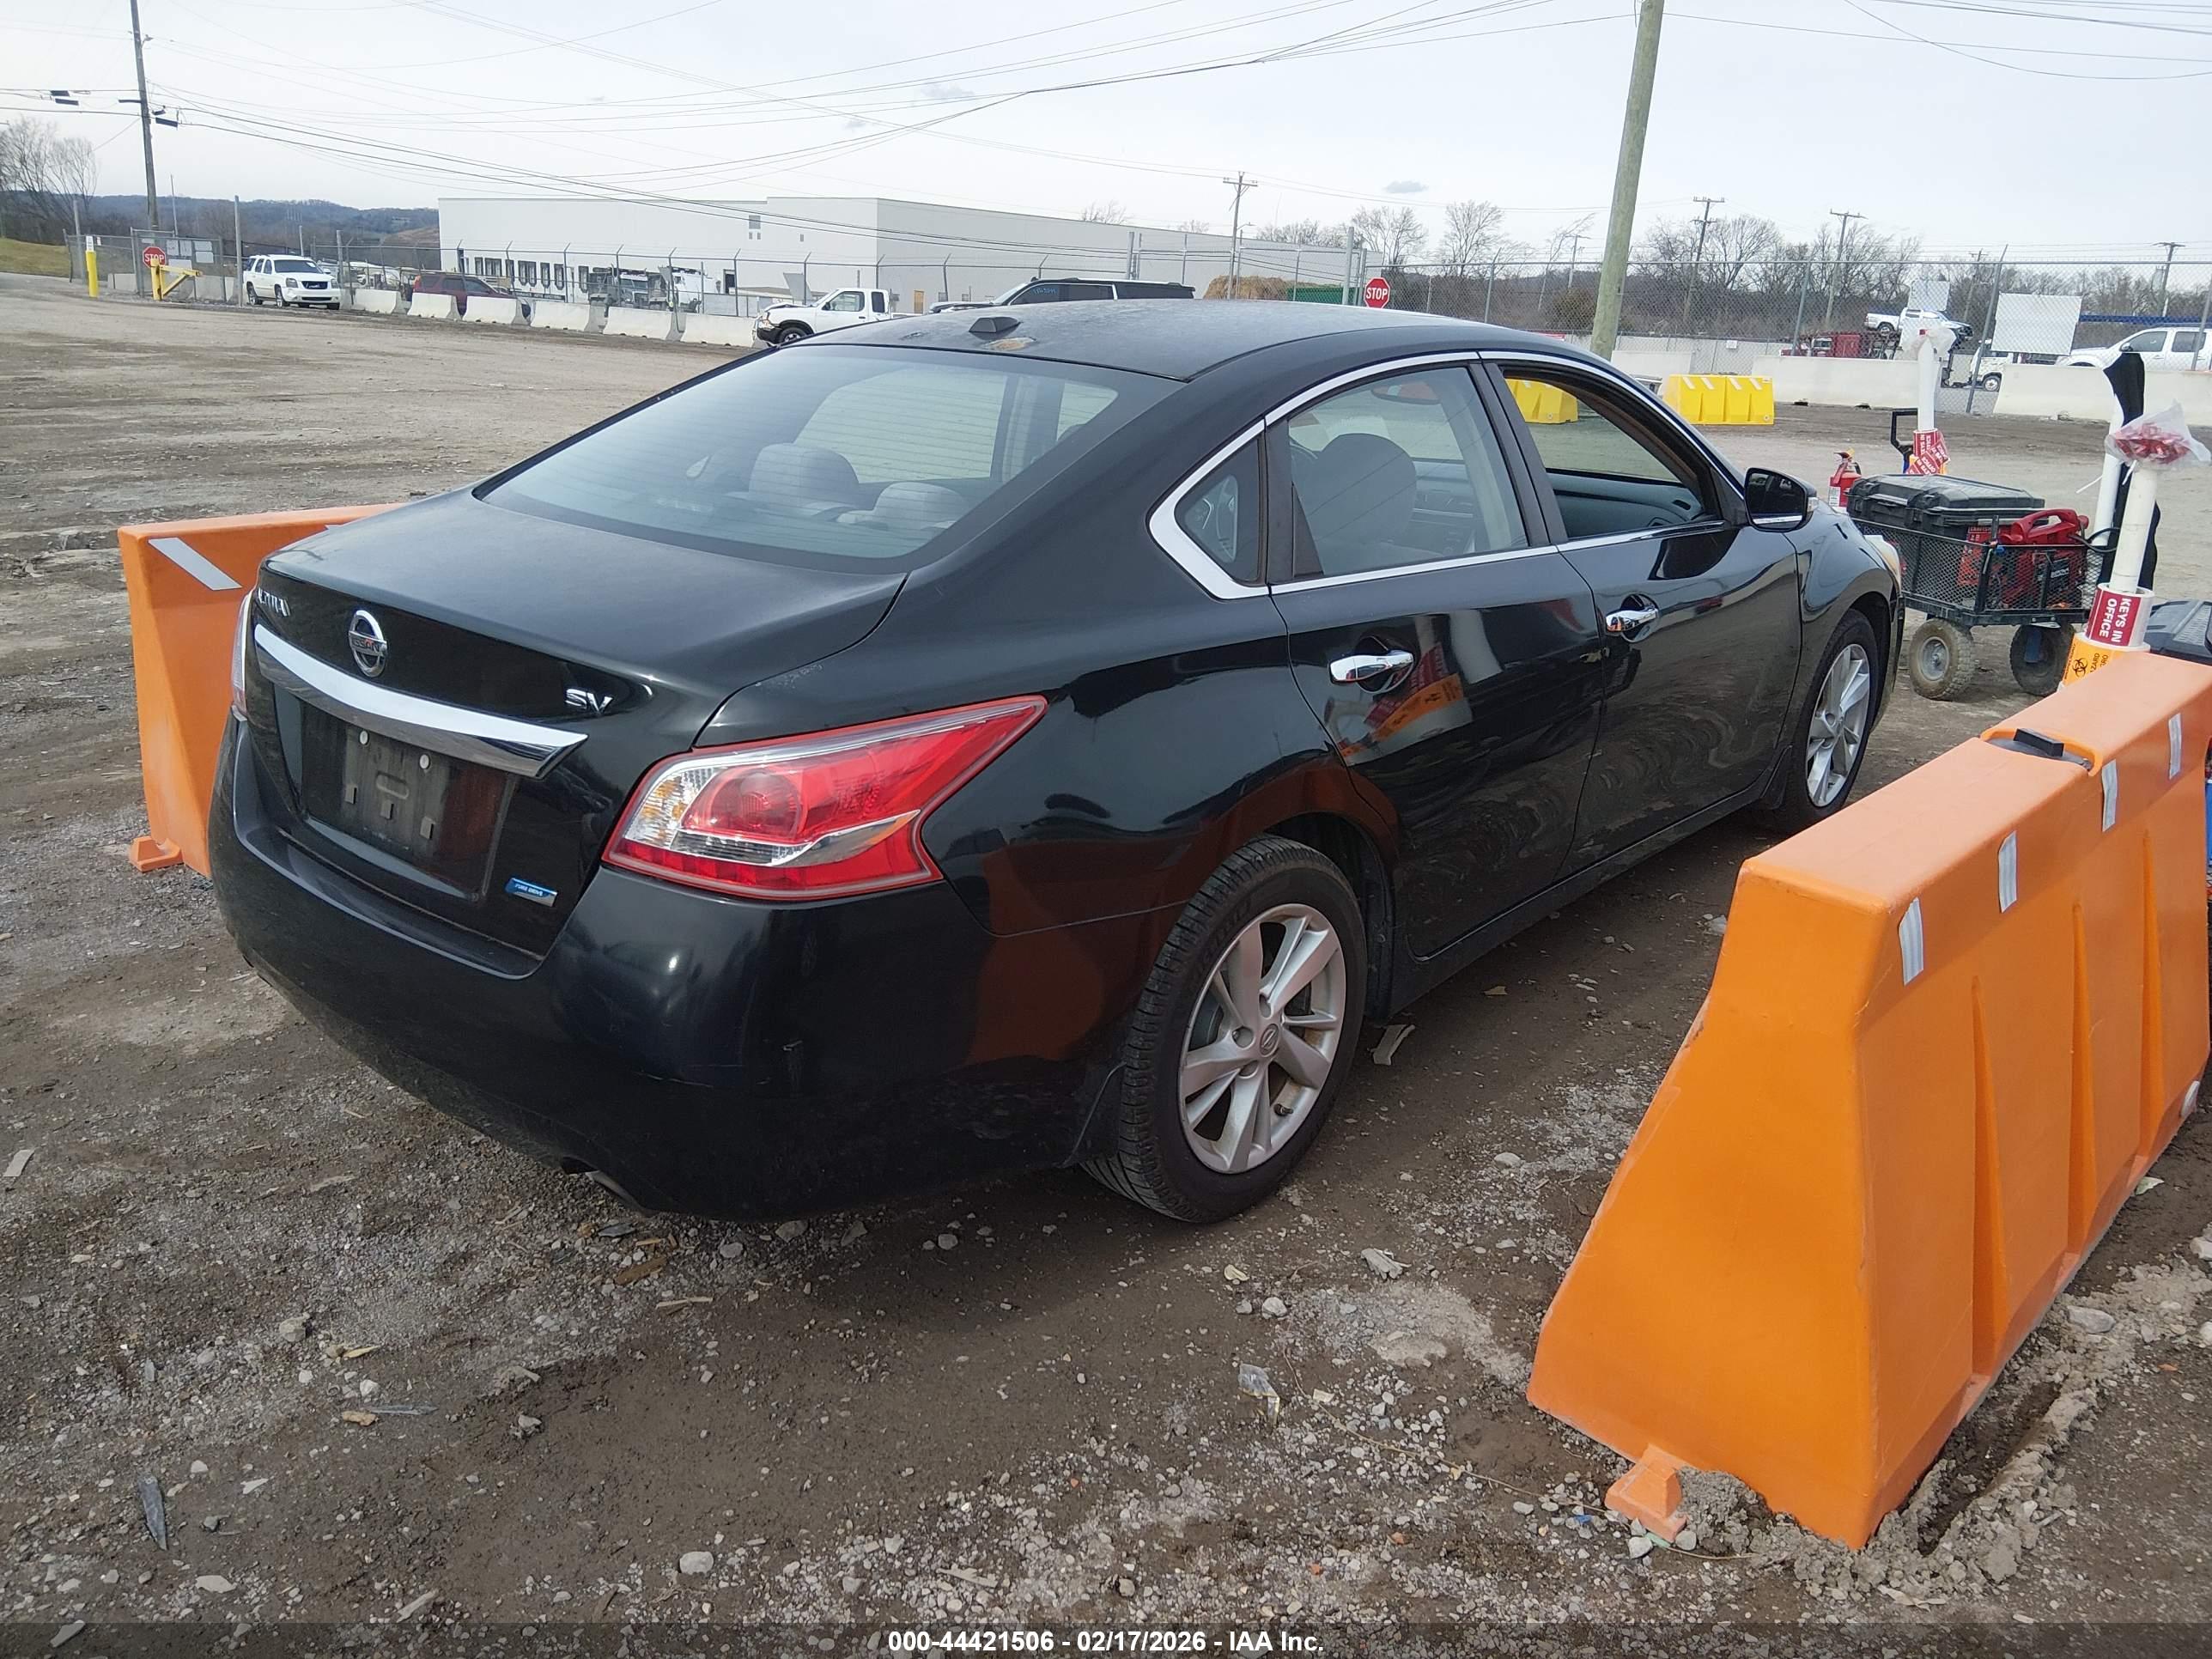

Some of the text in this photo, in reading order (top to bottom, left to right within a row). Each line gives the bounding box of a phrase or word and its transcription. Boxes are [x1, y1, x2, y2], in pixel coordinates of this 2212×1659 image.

[1365, 287, 1388, 301] STOP
[2099, 599, 2118, 638] OFFICE
[2111, 598, 2132, 643] KEYS IN
[565, 688, 613, 714] SV
